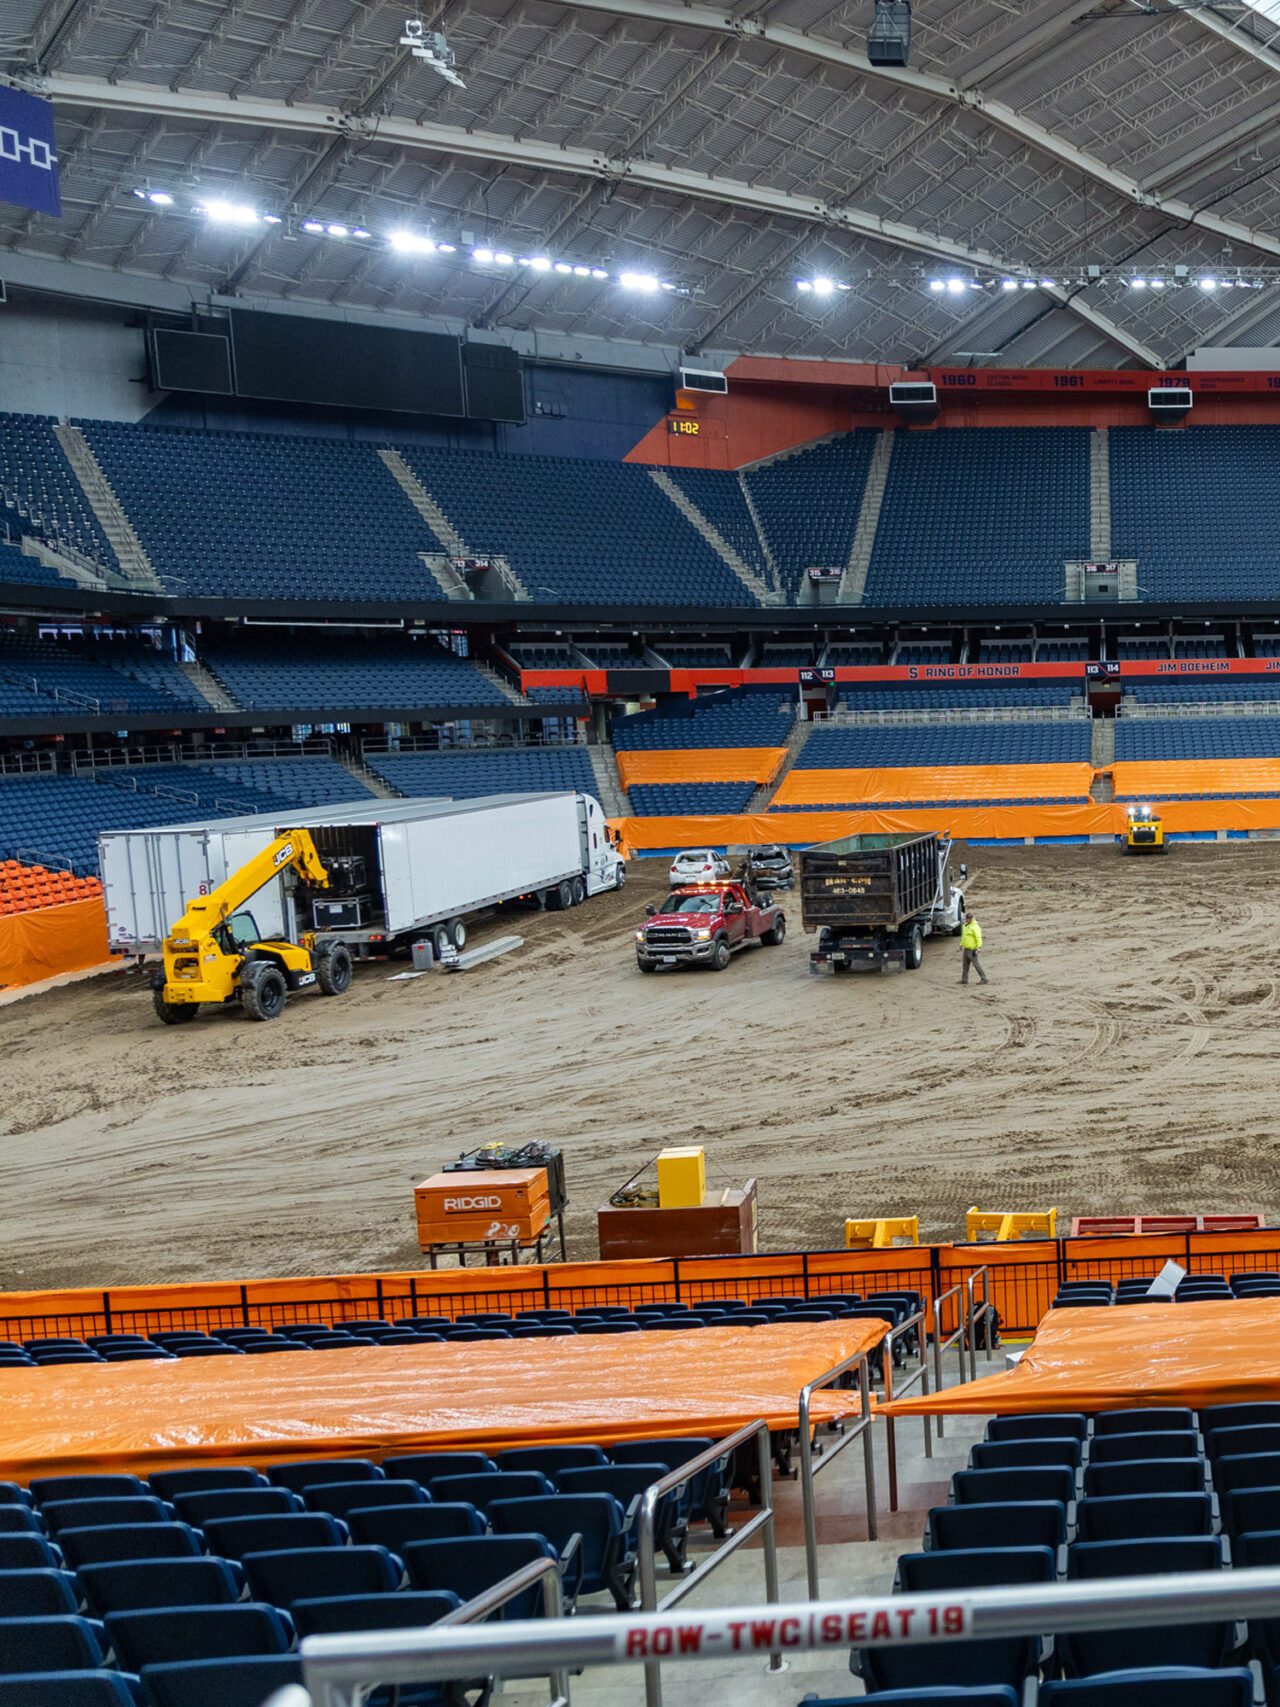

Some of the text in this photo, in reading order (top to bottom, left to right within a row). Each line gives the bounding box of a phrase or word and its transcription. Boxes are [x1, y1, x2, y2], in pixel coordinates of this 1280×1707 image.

[941, 374, 976, 386] 1960
[1054, 376, 1084, 386] 1961
[1158, 378, 1190, 388] 1979
[673, 422, 699, 434] 11:02
[926, 667, 955, 677] RING
[958, 667, 973, 676] OF
[977, 666, 1020, 676] HONOR
[1087, 663, 1119, 674] 113 114
[1157, 662, 1230, 672] JIM BOEHEIM
[800, 670, 834, 680] 112 113
[274, 844, 293, 866] JCB
[199, 885, 207, 895] 8
[299, 973, 316, 985] JCB
[444, 1196, 501, 1210] RIDGID
[928, 1606, 964, 1635] 19
